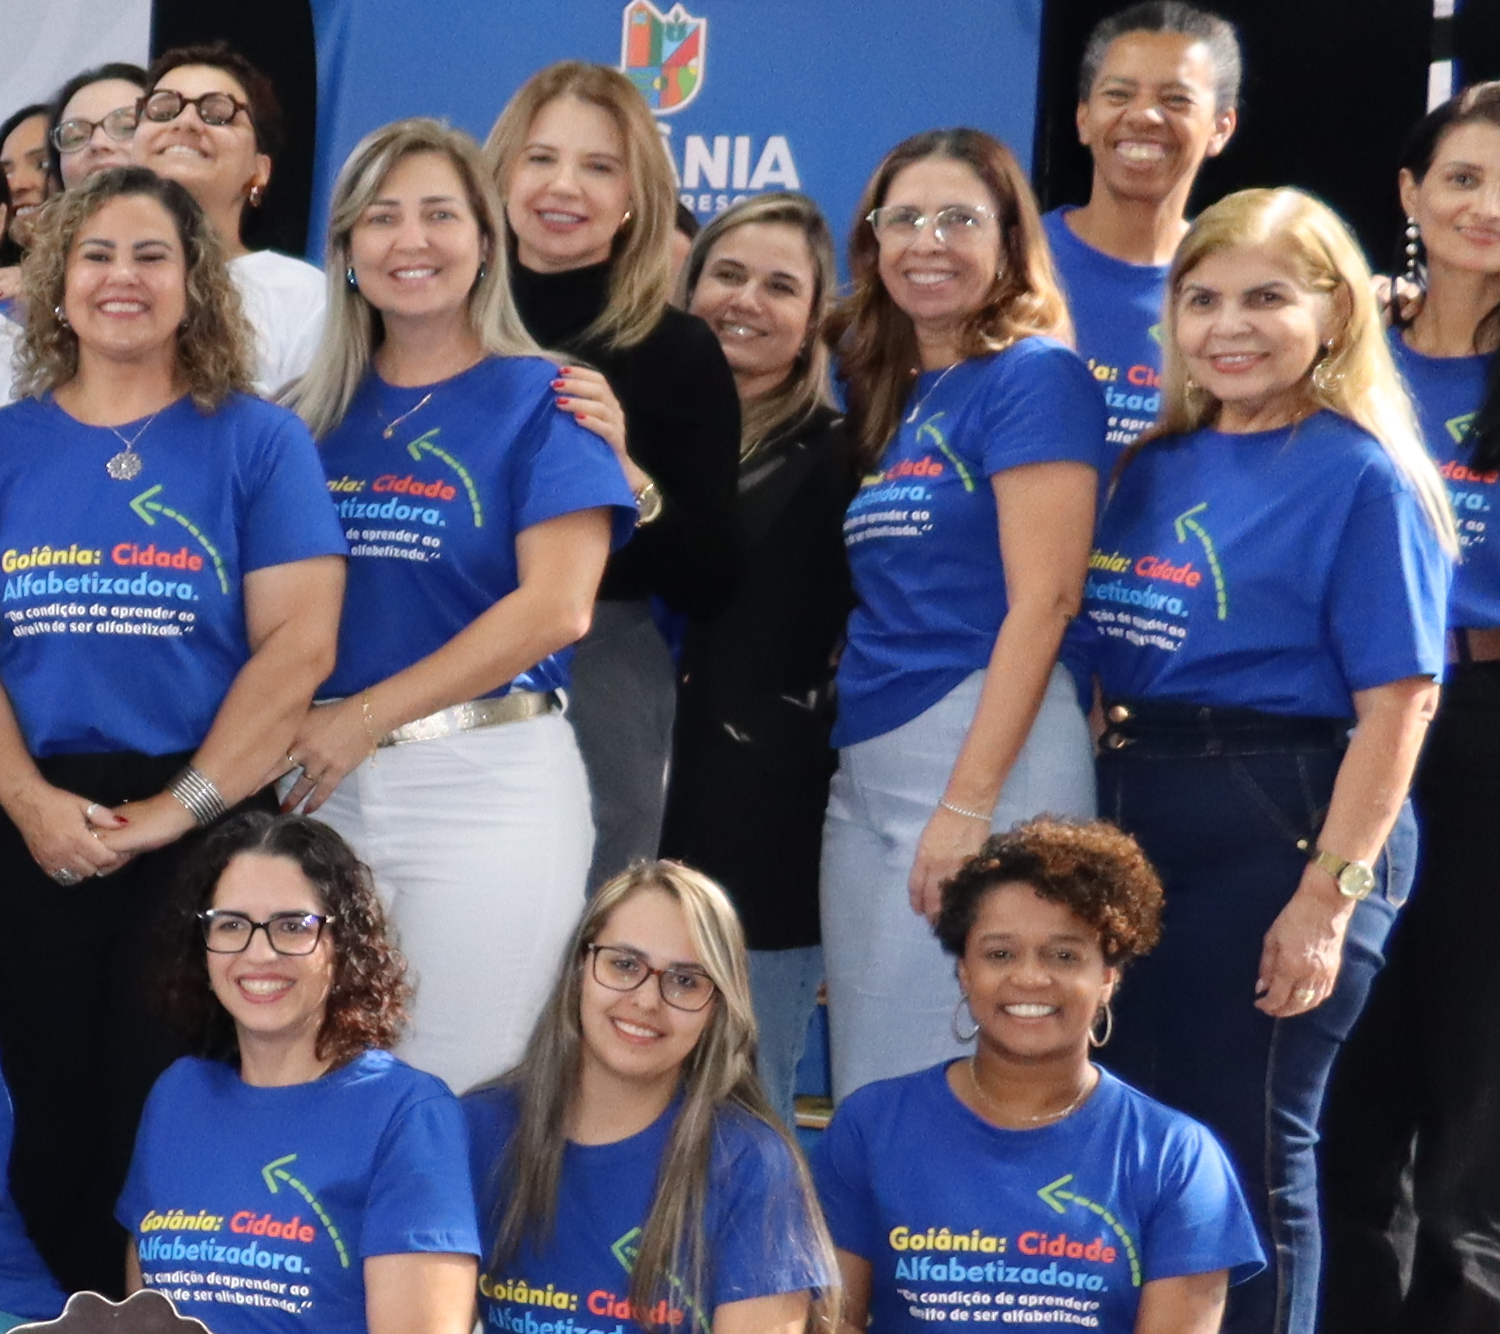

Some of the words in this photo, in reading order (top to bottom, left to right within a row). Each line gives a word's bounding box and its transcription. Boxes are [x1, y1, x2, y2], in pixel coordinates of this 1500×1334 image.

[373, 475, 457, 501] Cidade
[2, 549, 102, 573] Goiânia:
[111, 543, 203, 572] Cidade
[1135, 556, 1202, 587] Cidade
[3, 572, 199, 602] Alfabetizadora.
[140, 1210, 224, 1233] Goiânia:
[230, 1211, 316, 1244] Cidade
[138, 1236, 311, 1276] Alfabetizadora.
[889, 1227, 1007, 1253] Goiânia:
[1018, 1231, 1117, 1264] Cidade
[895, 1256, 1108, 1293] Alfabetizadora.
